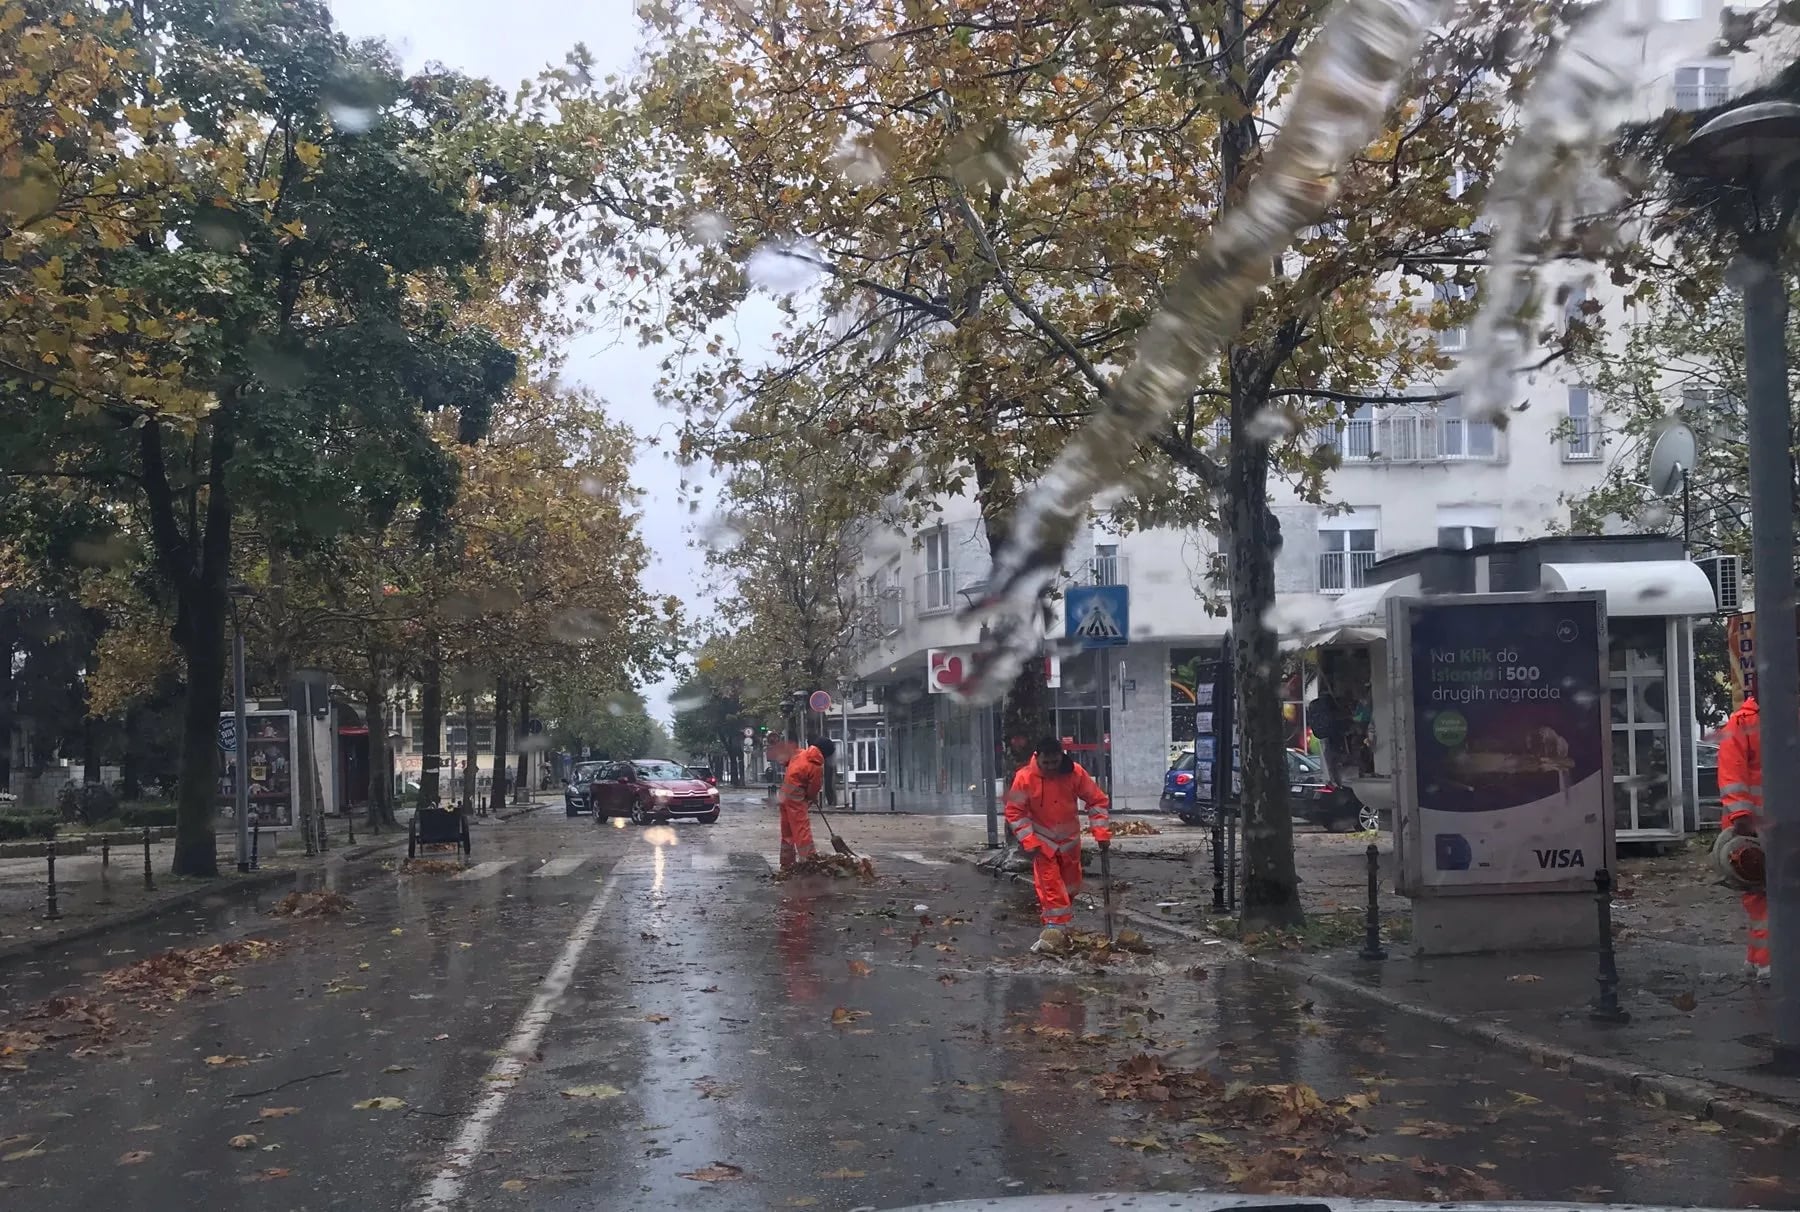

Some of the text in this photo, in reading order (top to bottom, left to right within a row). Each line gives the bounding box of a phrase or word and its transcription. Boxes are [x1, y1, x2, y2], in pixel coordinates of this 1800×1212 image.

[1430, 648, 1518, 663] Na Klik do
[1498, 666, 1502, 681] i
[1506, 666, 1540, 681] 500
[1432, 684, 1561, 704] drugih nagrada
[1532, 849, 1585, 869] VISA
